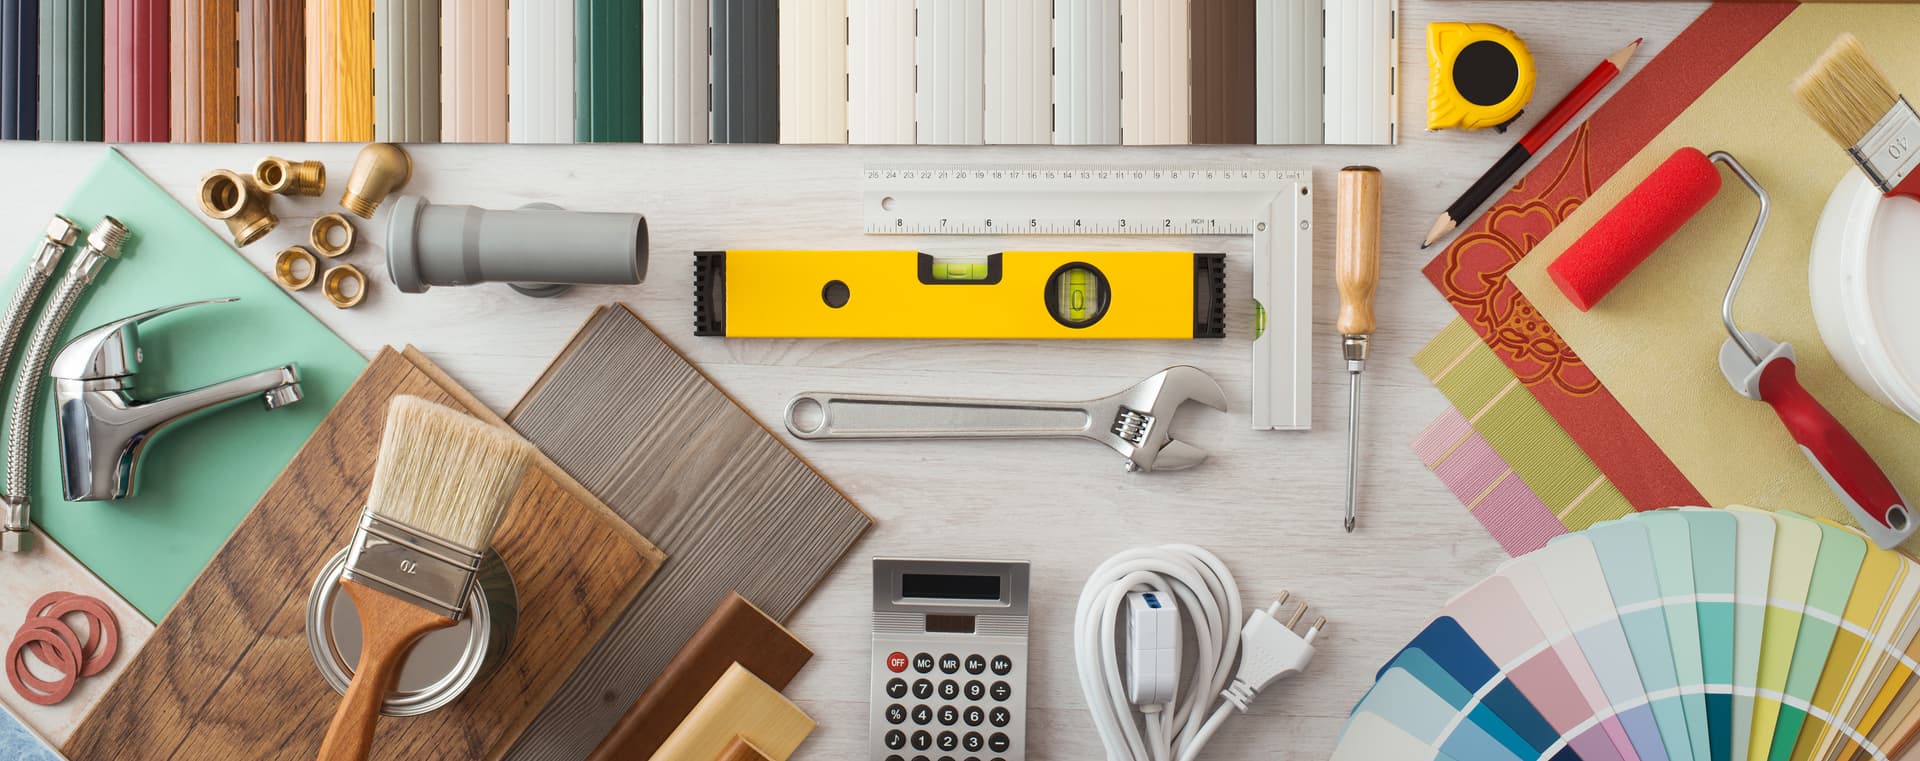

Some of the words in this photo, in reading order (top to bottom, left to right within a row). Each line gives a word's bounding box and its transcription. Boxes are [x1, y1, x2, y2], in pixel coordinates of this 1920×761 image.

[897, 219, 903, 227] 8
[942, 219, 947, 227] 7
[986, 219, 992, 227] 6
[1031, 219, 1037, 227] 5
[1075, 219, 1081, 227] 4
[1120, 219, 1126, 227] 3
[1165, 219, 1171, 227] 2
[1210, 219, 1215, 227] 1
[891, 658, 905, 667] OFF
[917, 659, 931, 668] MC
[943, 660, 956, 668] MR
[995, 661, 1008, 670] M+
[919, 684, 928, 694] 7
[945, 684, 953, 694] 8
[971, 685, 979, 695] 9
[918, 710, 927, 720] 4
[944, 710, 953, 721] 5
[970, 711, 979, 721] 6
[919, 736, 925, 746] 1
[943, 736, 952, 746] 2
[969, 737, 978, 747] 3
